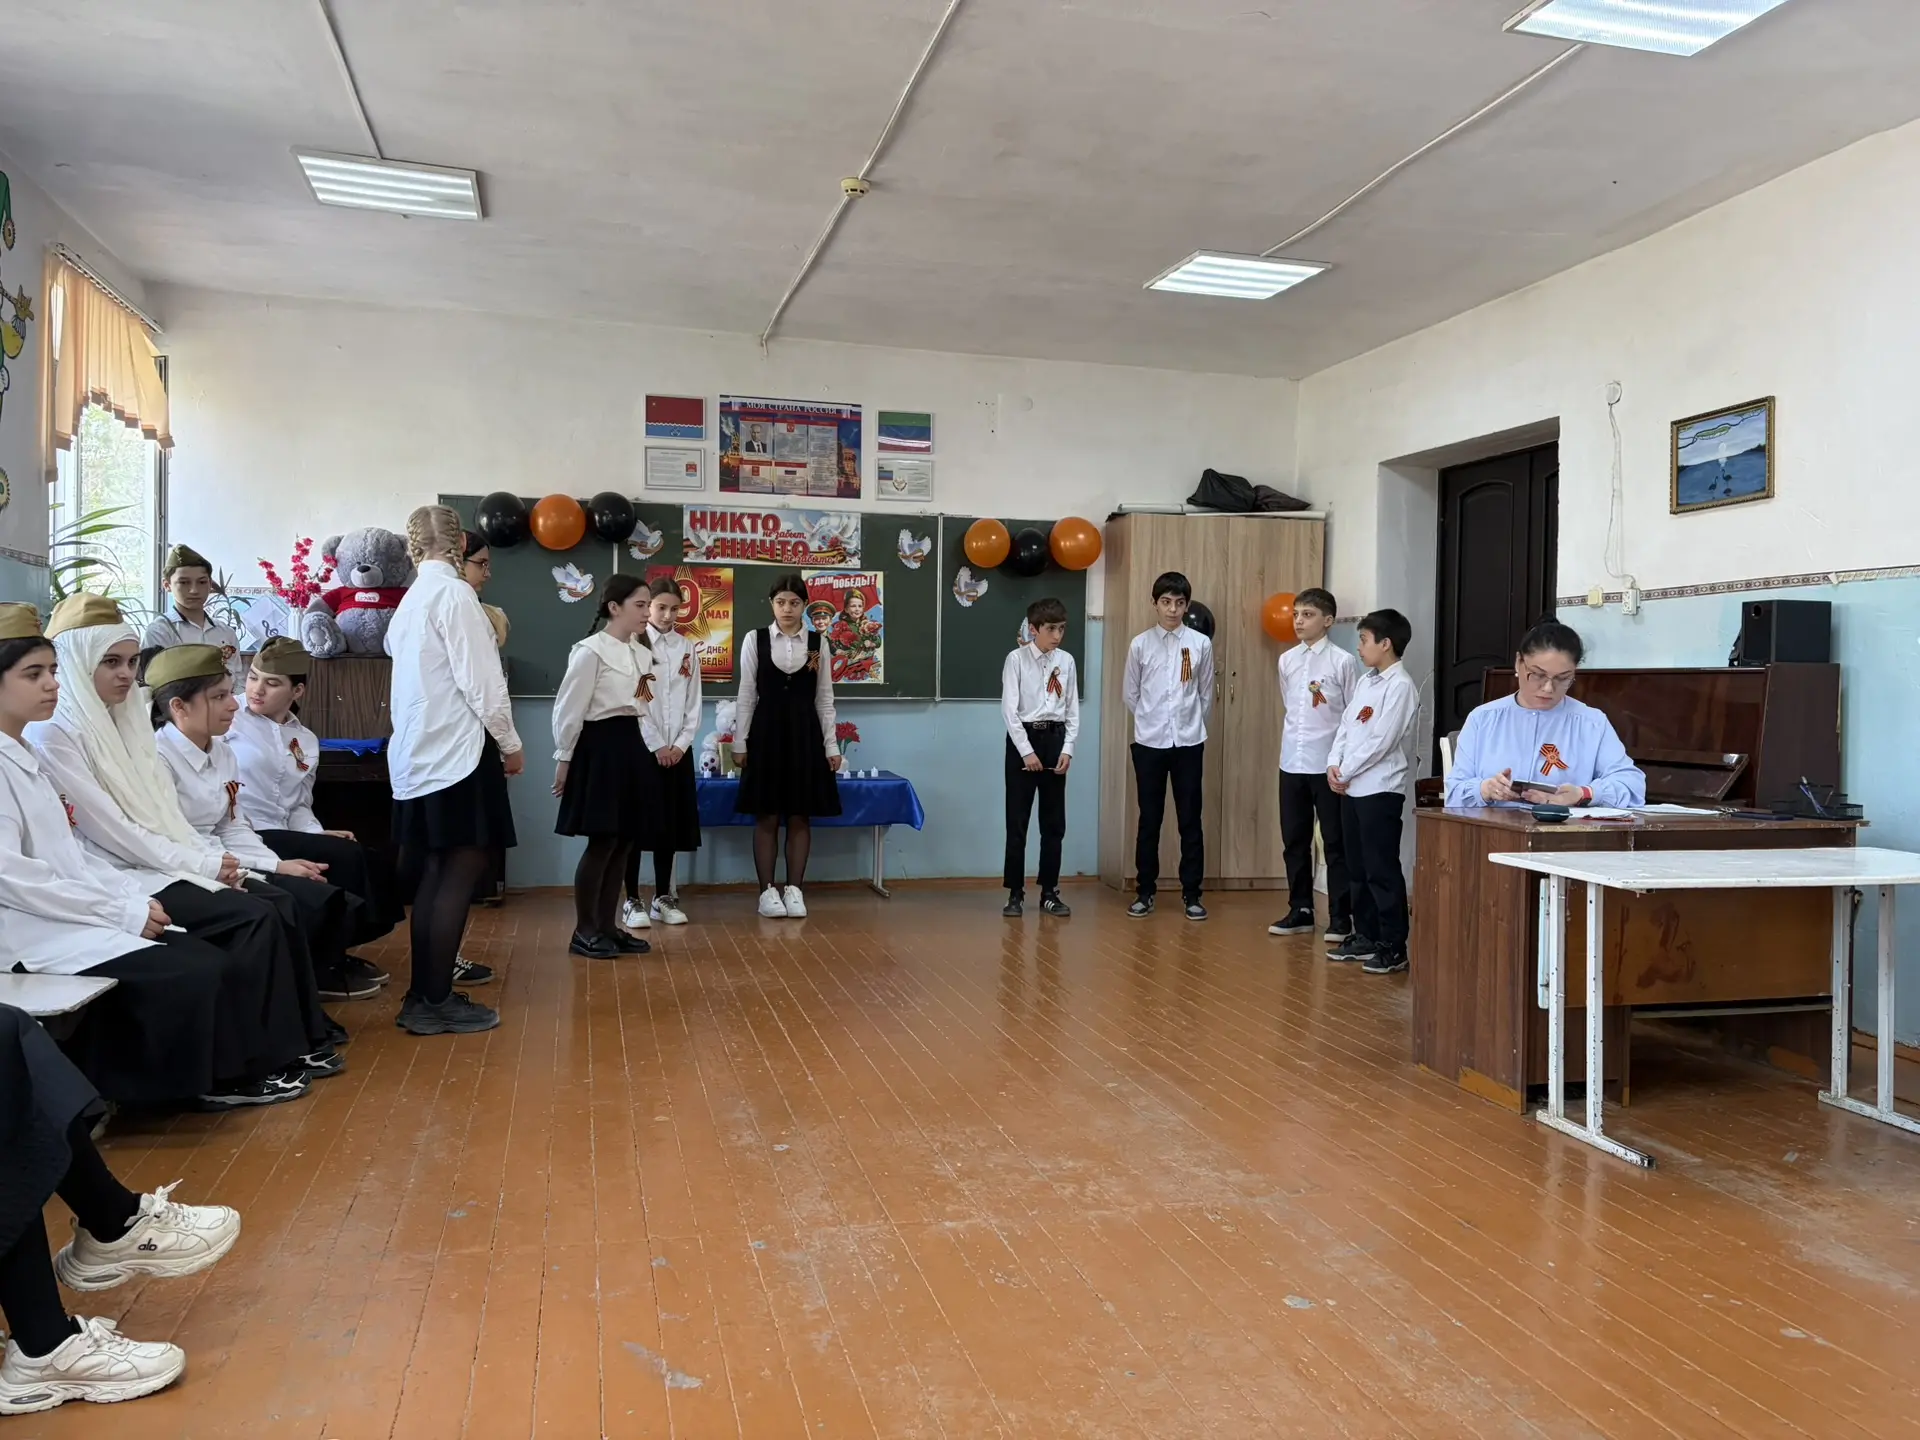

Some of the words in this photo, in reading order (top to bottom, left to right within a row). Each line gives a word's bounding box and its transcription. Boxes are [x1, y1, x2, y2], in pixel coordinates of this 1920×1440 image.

[769, 402, 801, 412] СТРАНА
[804, 405, 837, 414] РОССИЯ
[689, 510, 781, 534] НИКТО
[775, 529, 807, 540] забыт,
[719, 537, 811, 559] НИЧТО
[808, 578, 814, 586] С
[674, 578, 701, 625] 9
[706, 609, 729, 619] МАЯ
[694, 641, 706, 653] С
[699, 657, 728, 667] БЕДЫ!
